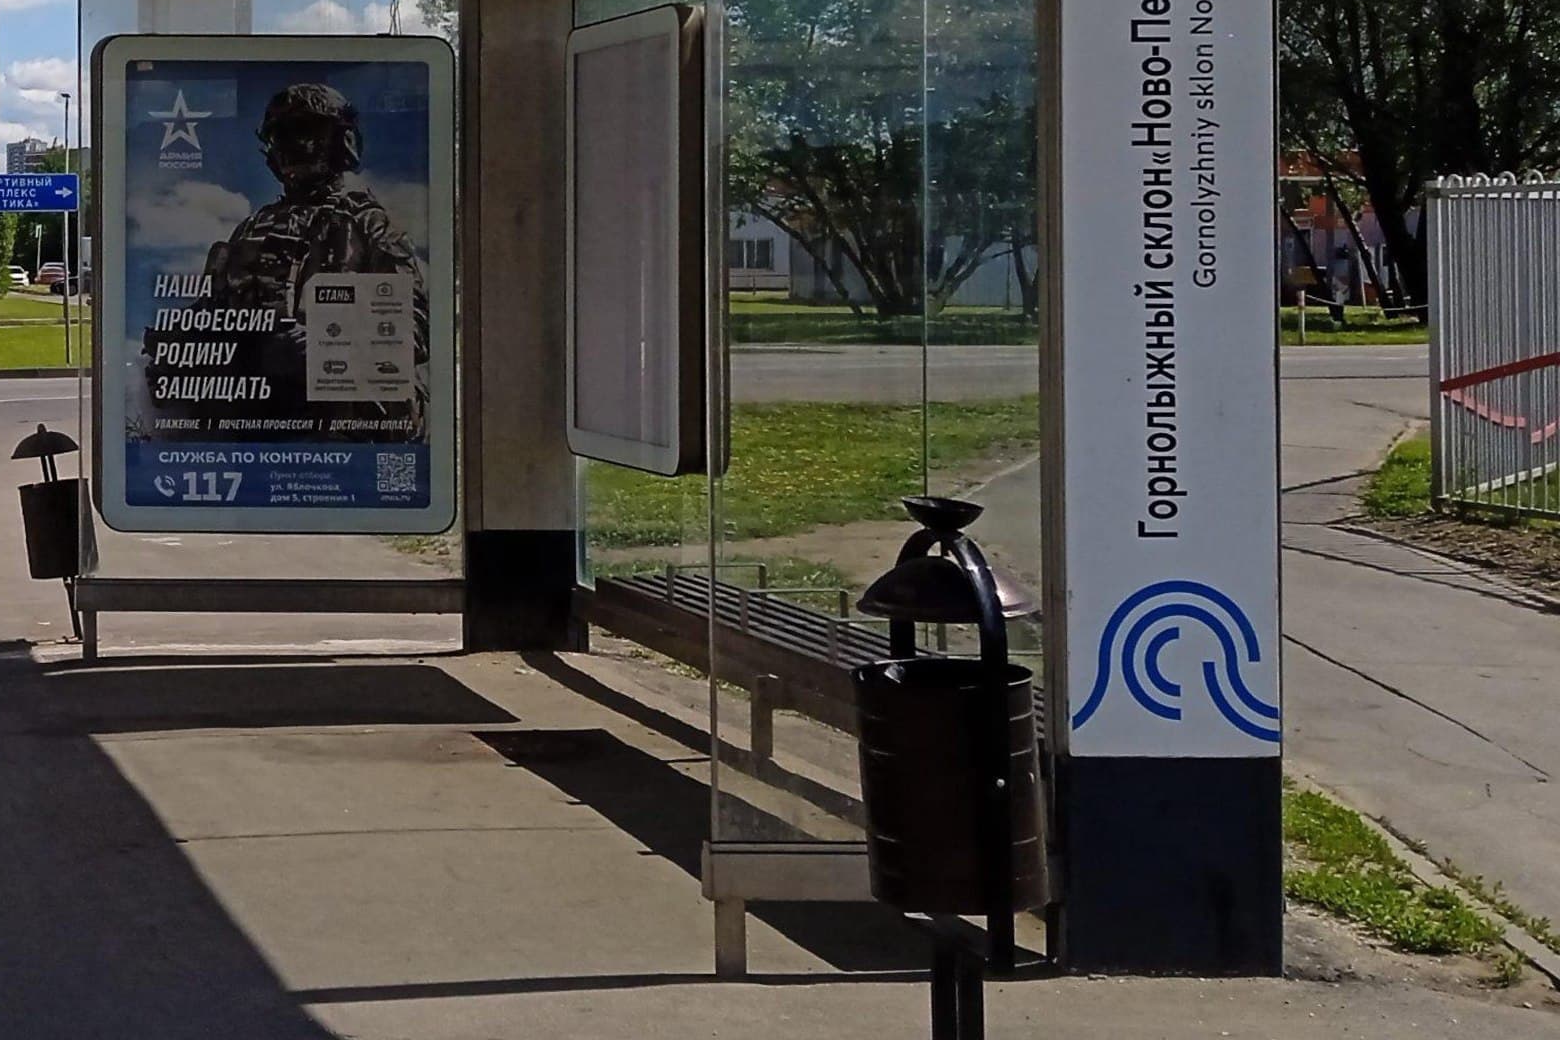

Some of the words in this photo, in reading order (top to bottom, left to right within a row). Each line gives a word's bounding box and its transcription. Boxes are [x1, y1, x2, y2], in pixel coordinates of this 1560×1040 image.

[1189, 43, 1214, 110] sklon
[1190, 117, 1221, 289] Gornolyzhniy
[1143, 167, 1174, 270] склон
[153, 273, 213, 299] НАША
[153, 308, 276, 333] ПРОФЕССИЯ
[154, 342, 238, 369] РОДИНУ
[154, 376, 272, 403] ЗАЩИЩАТЬ
[1133, 280, 1188, 539] Горнолыжный
[154, 418, 201, 430] УВАЖЕНИЕ
[218, 418, 262, 430] ПОЧЕТНАЯ
[262, 418, 314, 431] ПРОФЕССИЯ
[329, 418, 379, 431] ДОСТОЙНАЯ
[380, 419, 414, 431] ОПЛАТА
[158, 451, 227, 464] СЛУЖБА
[231, 451, 256, 463] ПО
[259, 451, 353, 464] КОНТРАКТУ
[181, 471, 243, 502] 117
[270, 494, 290, 503] дом
[351, 494, 356, 503] 1
